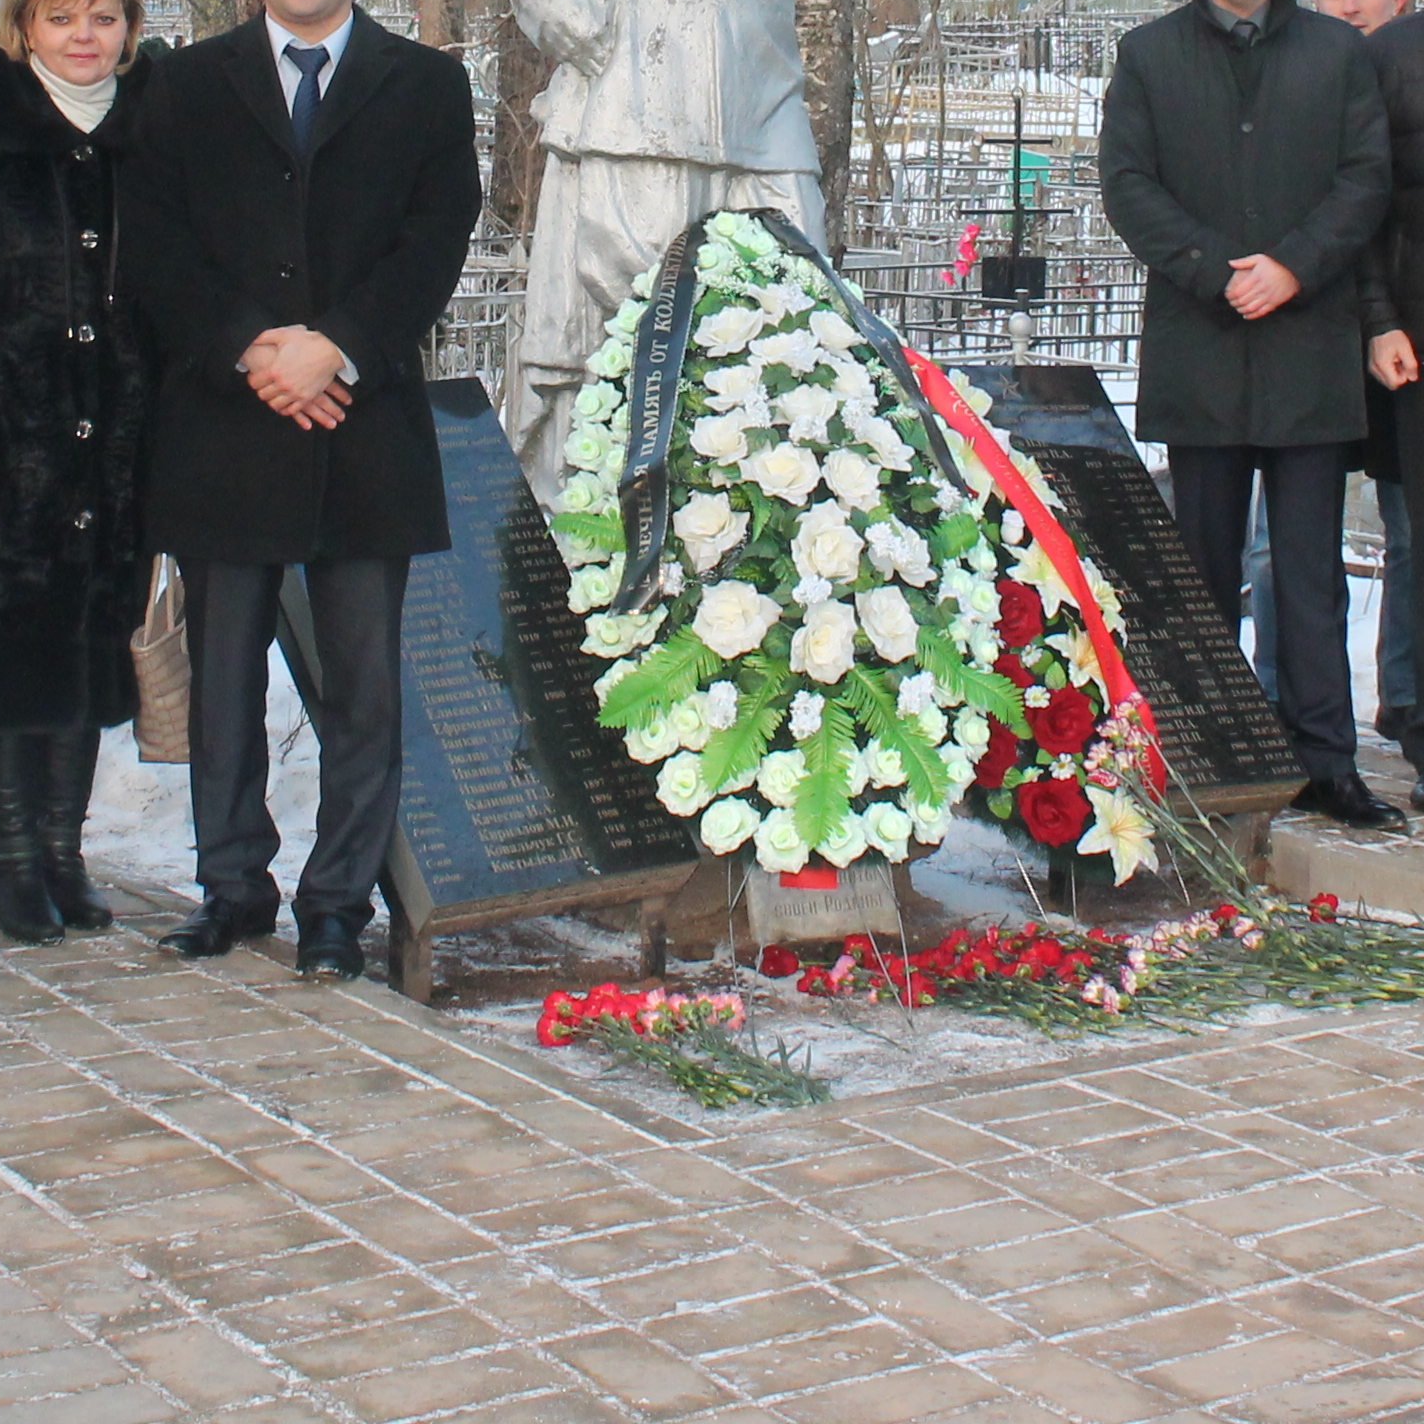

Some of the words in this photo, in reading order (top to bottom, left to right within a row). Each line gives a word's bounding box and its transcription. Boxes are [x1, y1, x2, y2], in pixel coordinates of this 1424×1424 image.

[649, 339, 669, 364] ОТ
[639, 369, 663, 458] ПАМЯТЬ
[452, 765, 502, 781] Иванов
[458, 780, 508, 795] Иванов
[484, 837, 555, 858] Ковальчук
[490, 852, 556, 874] Костылев
